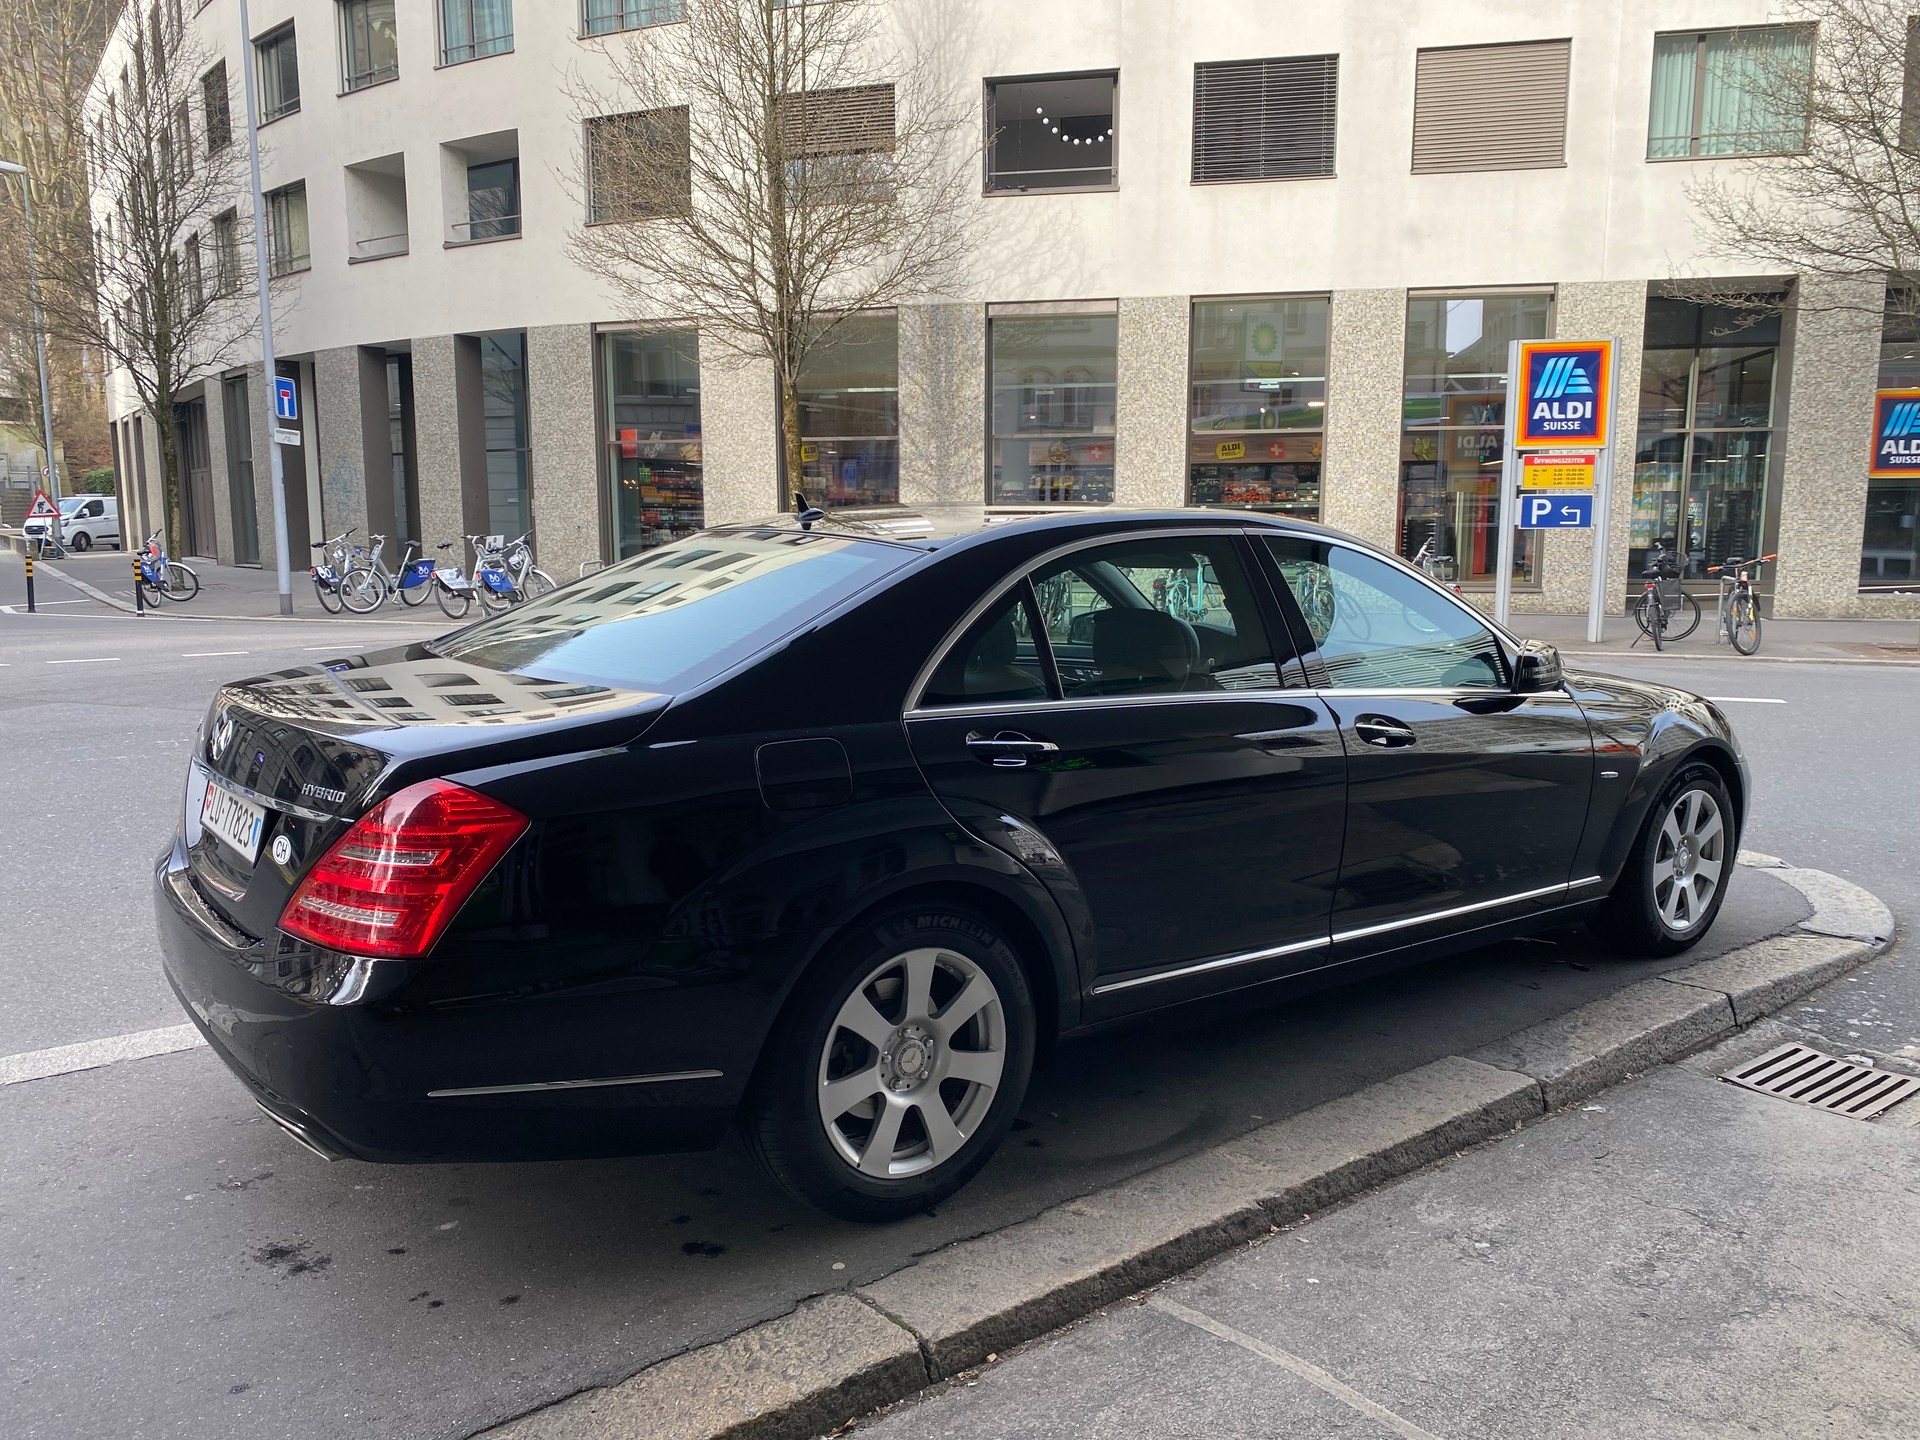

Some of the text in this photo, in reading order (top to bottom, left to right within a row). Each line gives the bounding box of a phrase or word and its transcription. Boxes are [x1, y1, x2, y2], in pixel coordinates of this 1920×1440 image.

[1533, 401, 1592, 419] ALDI
[1543, 421, 1580, 430] SUISSE
[1221, 443, 1240, 452] ALDI
[1531, 499, 1552, 525] P
[301, 783, 346, 803] HYBRID
[276, 840, 288, 860] CH
[917, 915, 993, 945] MICHELIN
[999, 950, 1024, 991] PRIMACY
